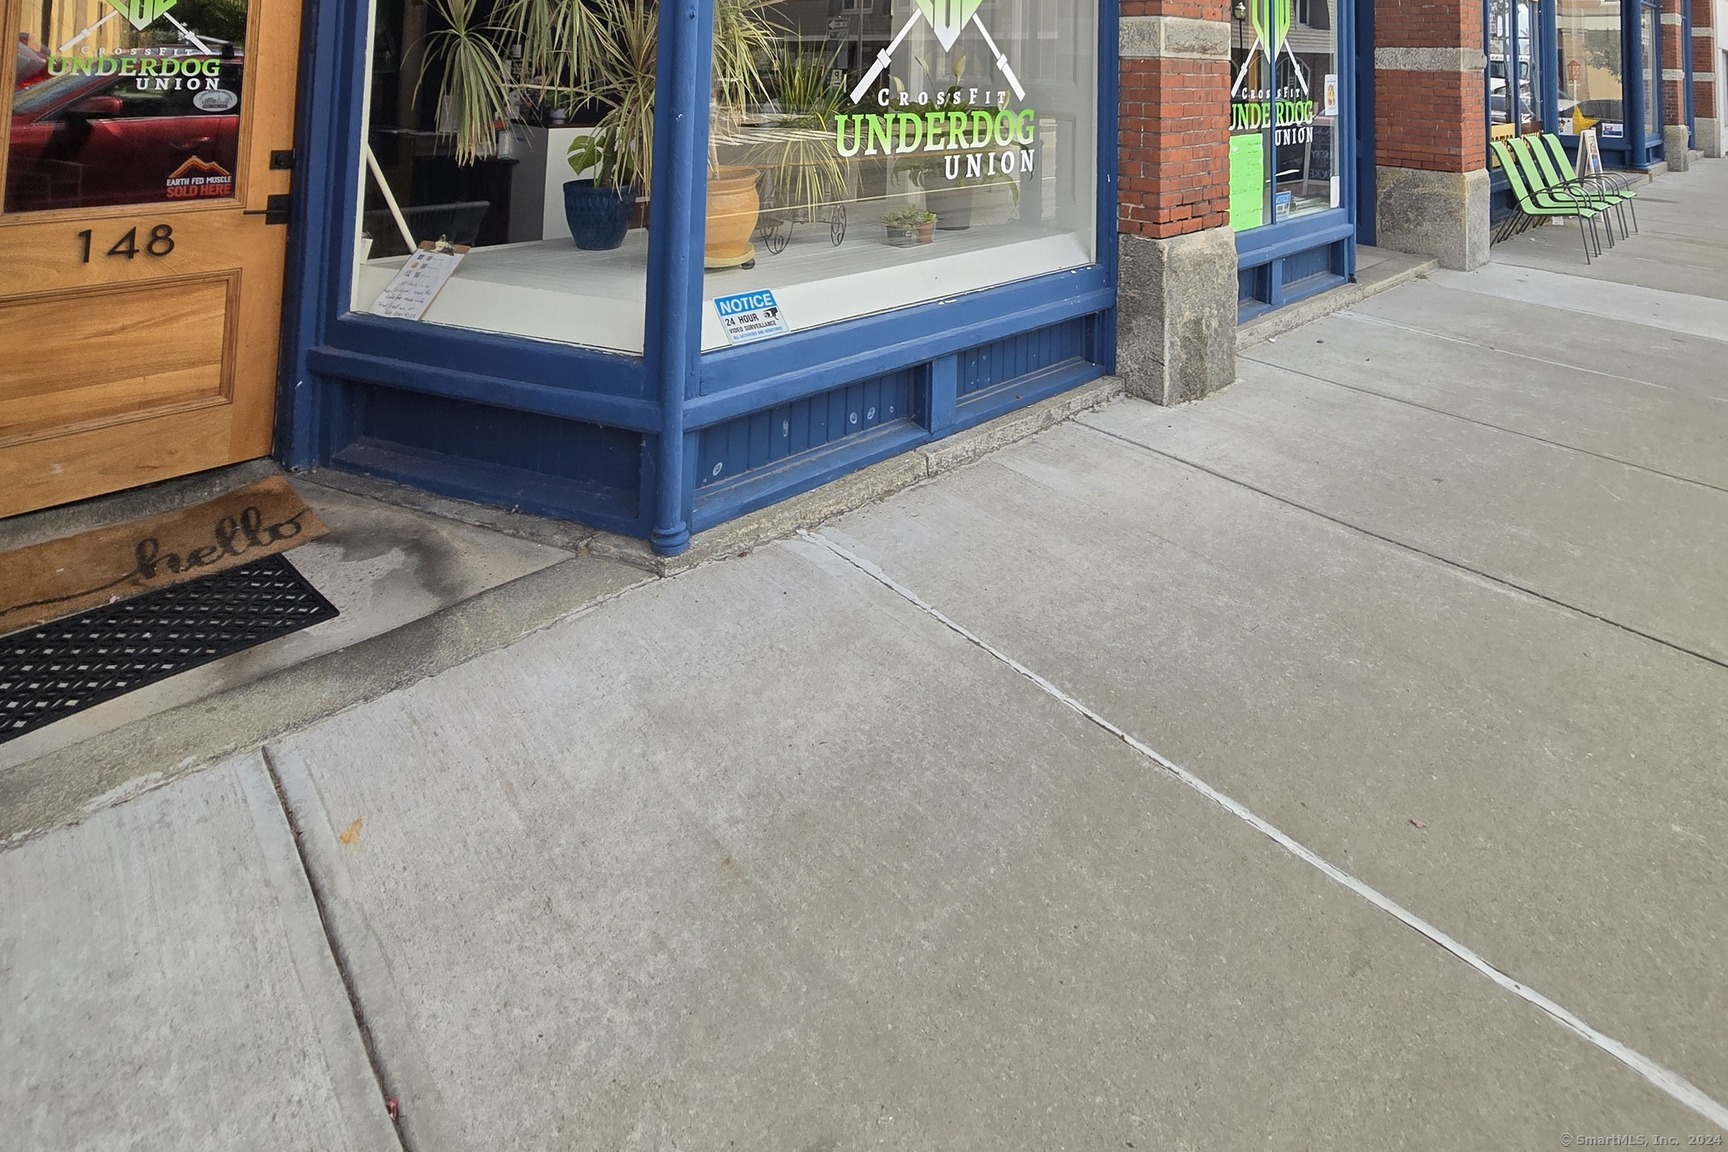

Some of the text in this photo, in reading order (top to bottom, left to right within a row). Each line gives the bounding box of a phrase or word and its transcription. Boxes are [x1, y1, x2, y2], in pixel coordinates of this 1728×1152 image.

[47, 56, 221, 77] UNDERDOG
[136, 77, 220, 91] UNION
[835, 108, 1035, 158] UNDERDOG
[1275, 127, 1313, 146] UNION
[944, 149, 1035, 181] UNION
[166, 175, 232, 187] EARTH FED MUSCLE
[166, 184, 232, 198] SOLD HERE
[78, 224, 175, 263] 148
[719, 293, 774, 315] NOTICE
[725, 313, 759, 327] 24 HOUR
[728, 326, 744, 334] VIDEO
[132, 506, 312, 581] hello
